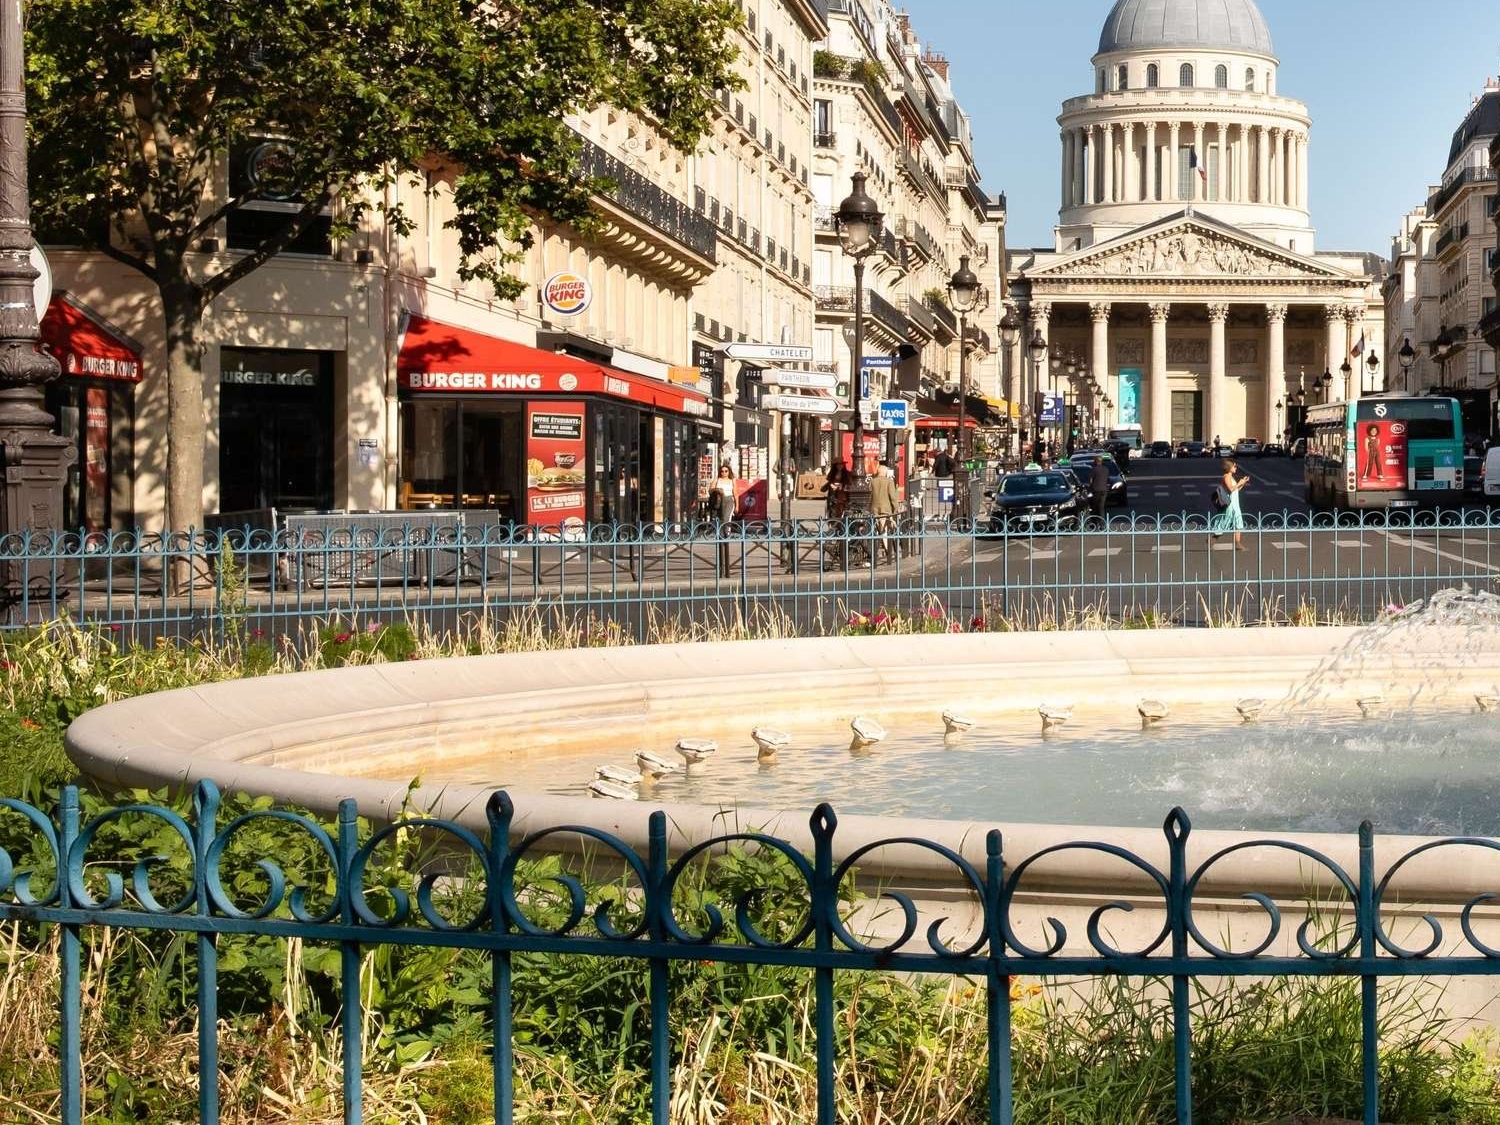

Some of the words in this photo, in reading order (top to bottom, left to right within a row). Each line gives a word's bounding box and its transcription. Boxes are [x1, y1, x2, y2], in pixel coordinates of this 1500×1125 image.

[549, 281, 585, 292] BURGER
[549, 289, 585, 303] KING
[769, 348, 809, 358] CHATELET
[81, 356, 116, 375] BURGER
[116, 361, 138, 378] KING
[276, 371, 315, 386] KING
[409, 373, 487, 389] BURGER
[491, 374, 542, 389] KING
[943, 487, 954, 501] P
